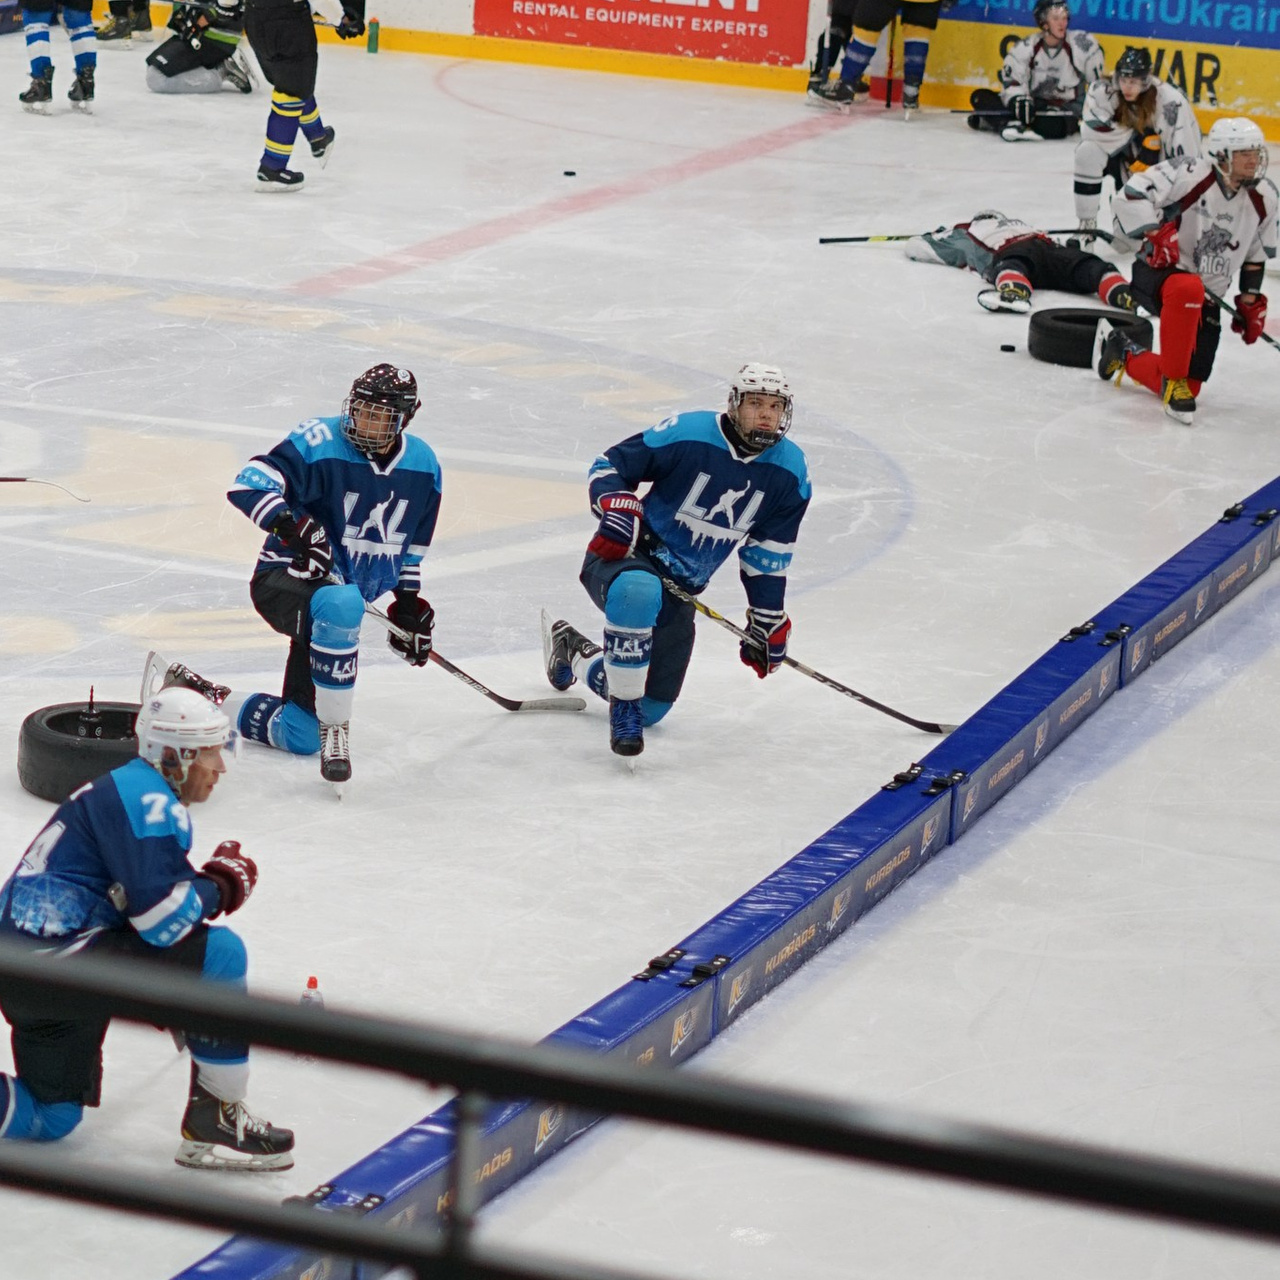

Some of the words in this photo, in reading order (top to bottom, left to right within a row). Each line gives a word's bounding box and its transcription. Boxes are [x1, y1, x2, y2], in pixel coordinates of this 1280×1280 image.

[512, 0, 580, 20] RENTAL
[585, 7, 686, 30] EQUIPMENT
[691, 17, 769, 39] EXPERTS
[864, 845, 912, 892] KURBADS
[764, 923, 817, 975] KURBADS
[436, 1147, 513, 1214] KADS
